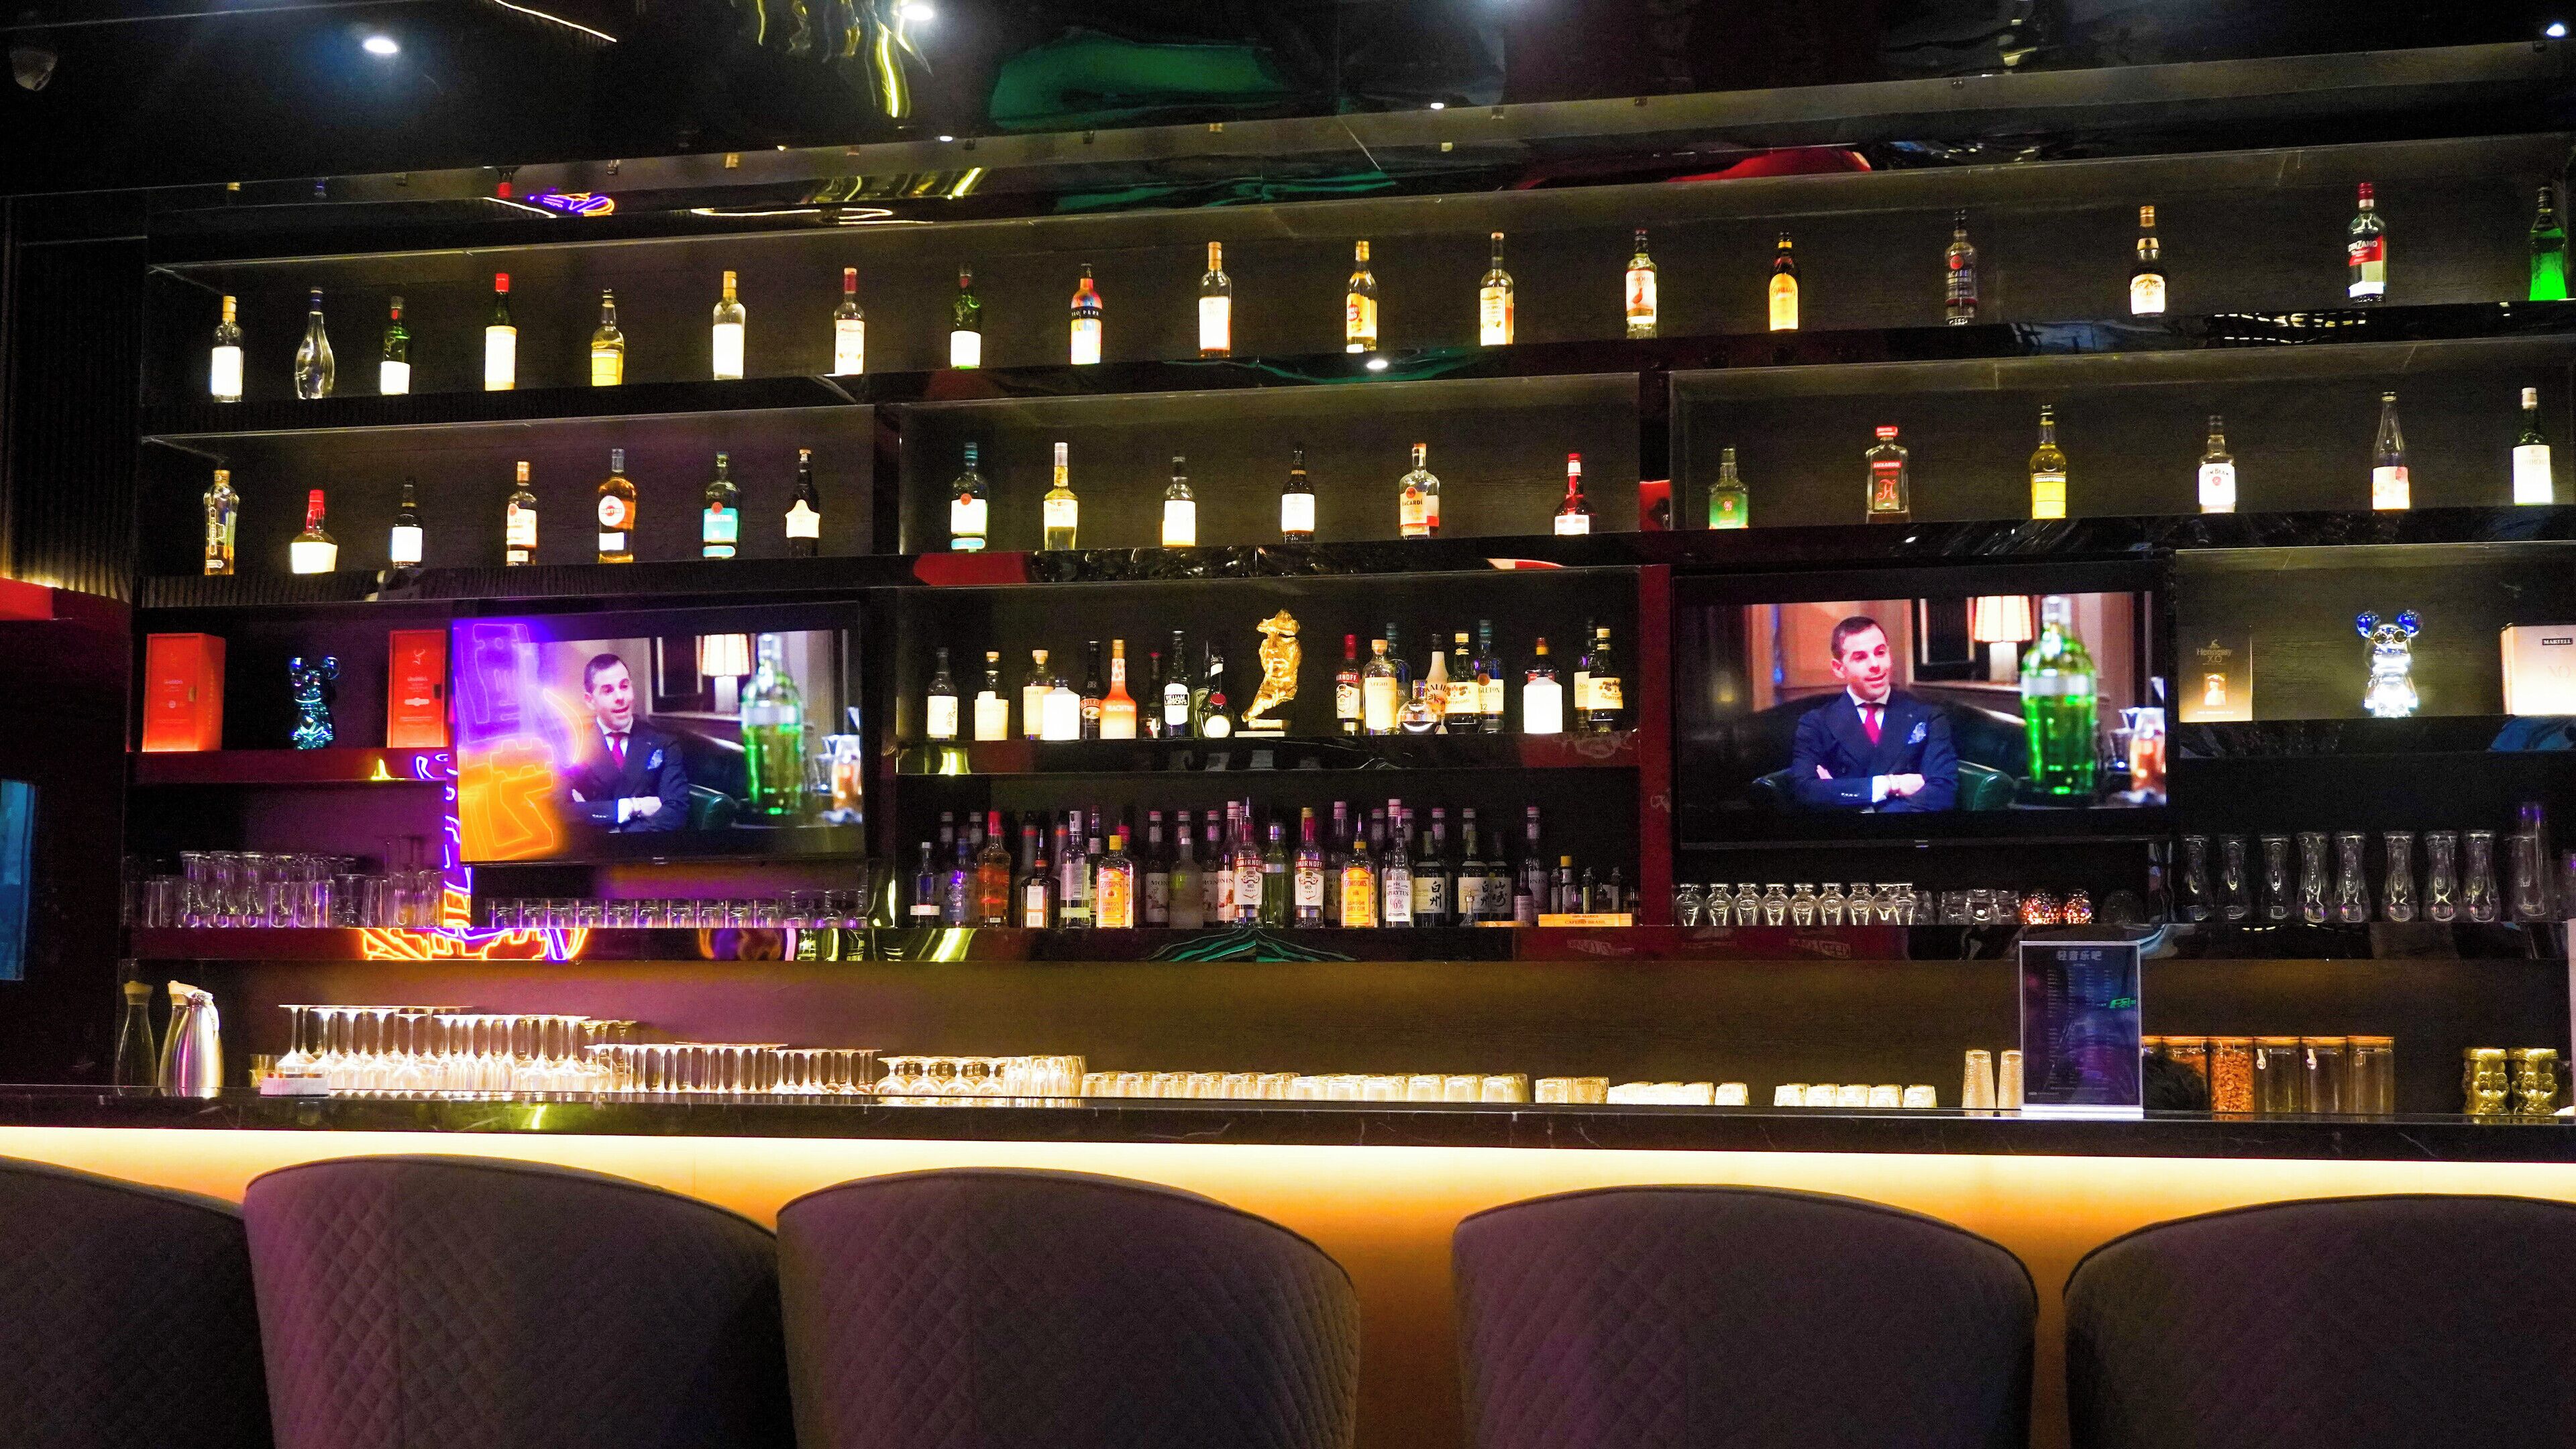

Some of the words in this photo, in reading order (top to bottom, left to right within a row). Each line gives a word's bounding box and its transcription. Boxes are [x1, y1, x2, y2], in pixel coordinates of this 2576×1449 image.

[1080, 699, 1100, 708] BAILEY
[1295, 859, 1323, 867] SMIRNOFF
[1429, 880, 1442, 909] 白州
[1389, 898, 1404, 910] 96%
